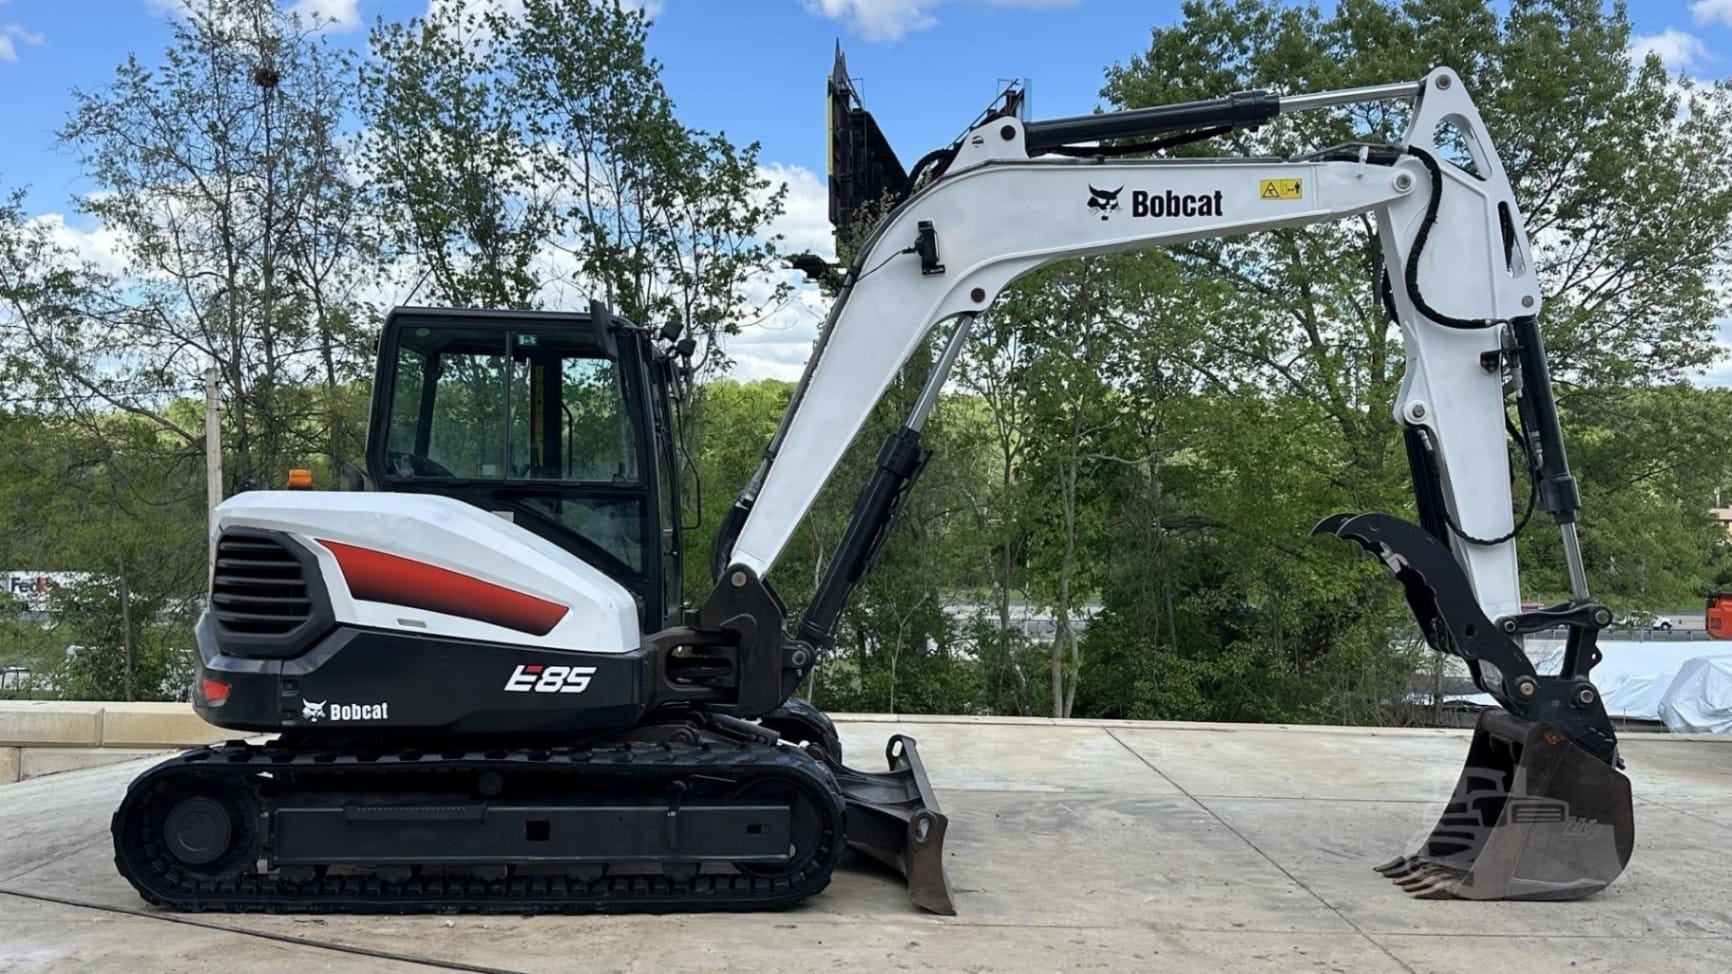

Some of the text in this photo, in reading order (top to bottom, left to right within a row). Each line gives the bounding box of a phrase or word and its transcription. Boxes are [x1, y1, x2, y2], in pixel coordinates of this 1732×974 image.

[1132, 189, 1223, 218] Bobcat
[11, 577, 49, 594] FedE
[504, 665, 598, 693] E85
[330, 702, 388, 721] Bobcat
